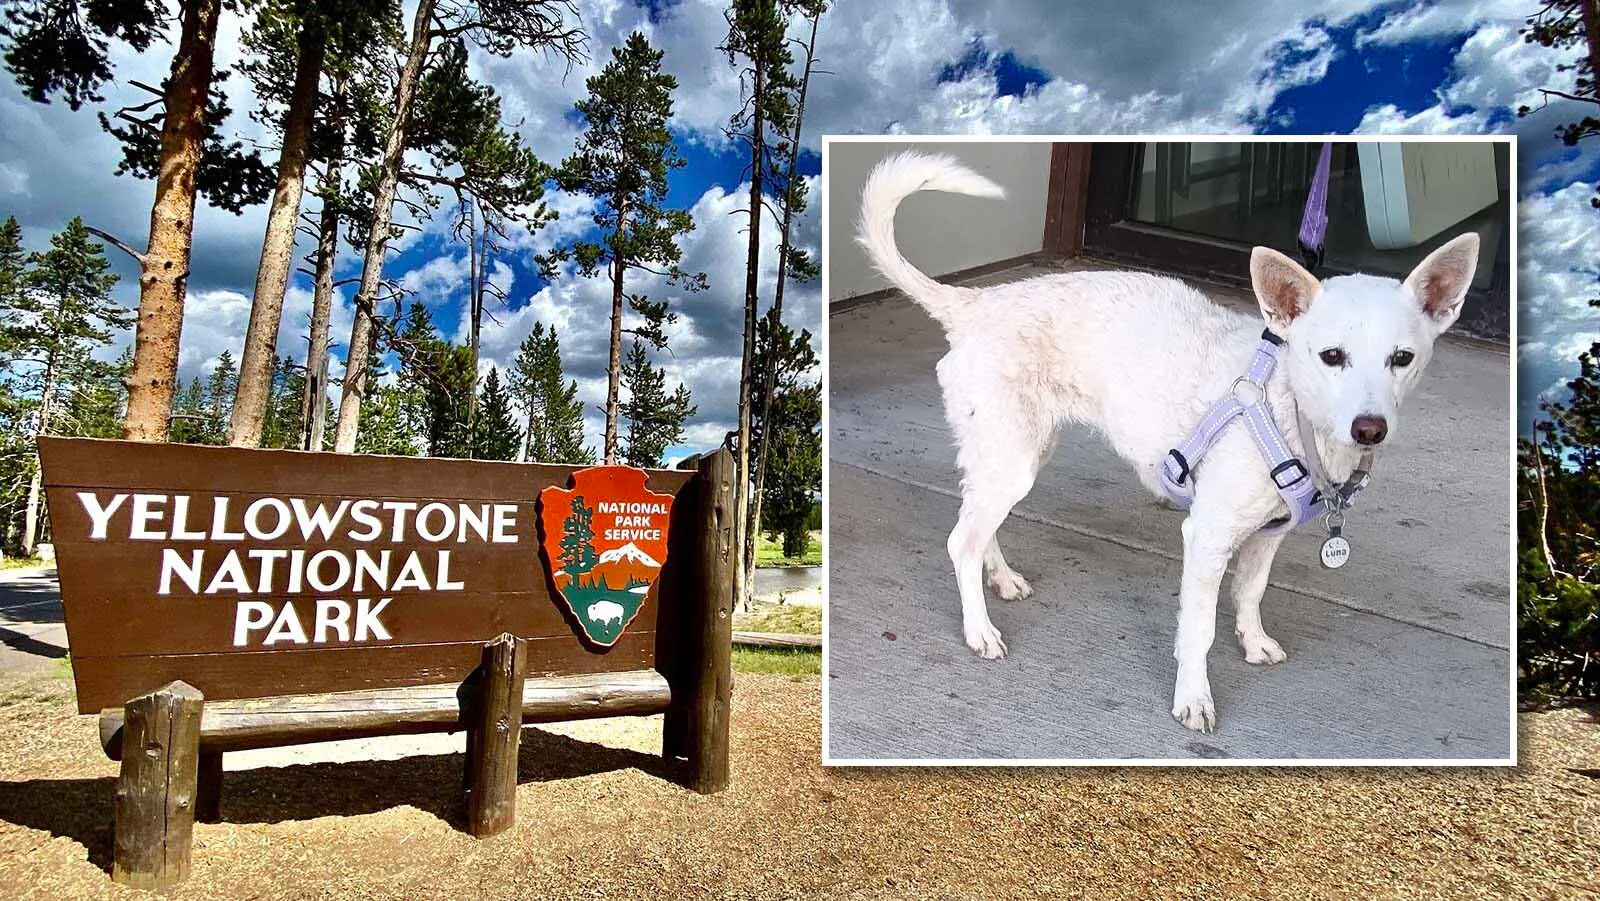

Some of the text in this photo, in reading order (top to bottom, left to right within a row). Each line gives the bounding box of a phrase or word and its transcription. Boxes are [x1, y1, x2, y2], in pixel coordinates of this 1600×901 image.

[76, 492, 519, 543] YELLOWSTONE
[598, 502, 668, 514] NATIONAL
[615, 516, 650, 527] PARK
[604, 529, 661, 541] SERVICE
[158, 549, 464, 595] NATIONAL
[233, 598, 393, 647] PARK
